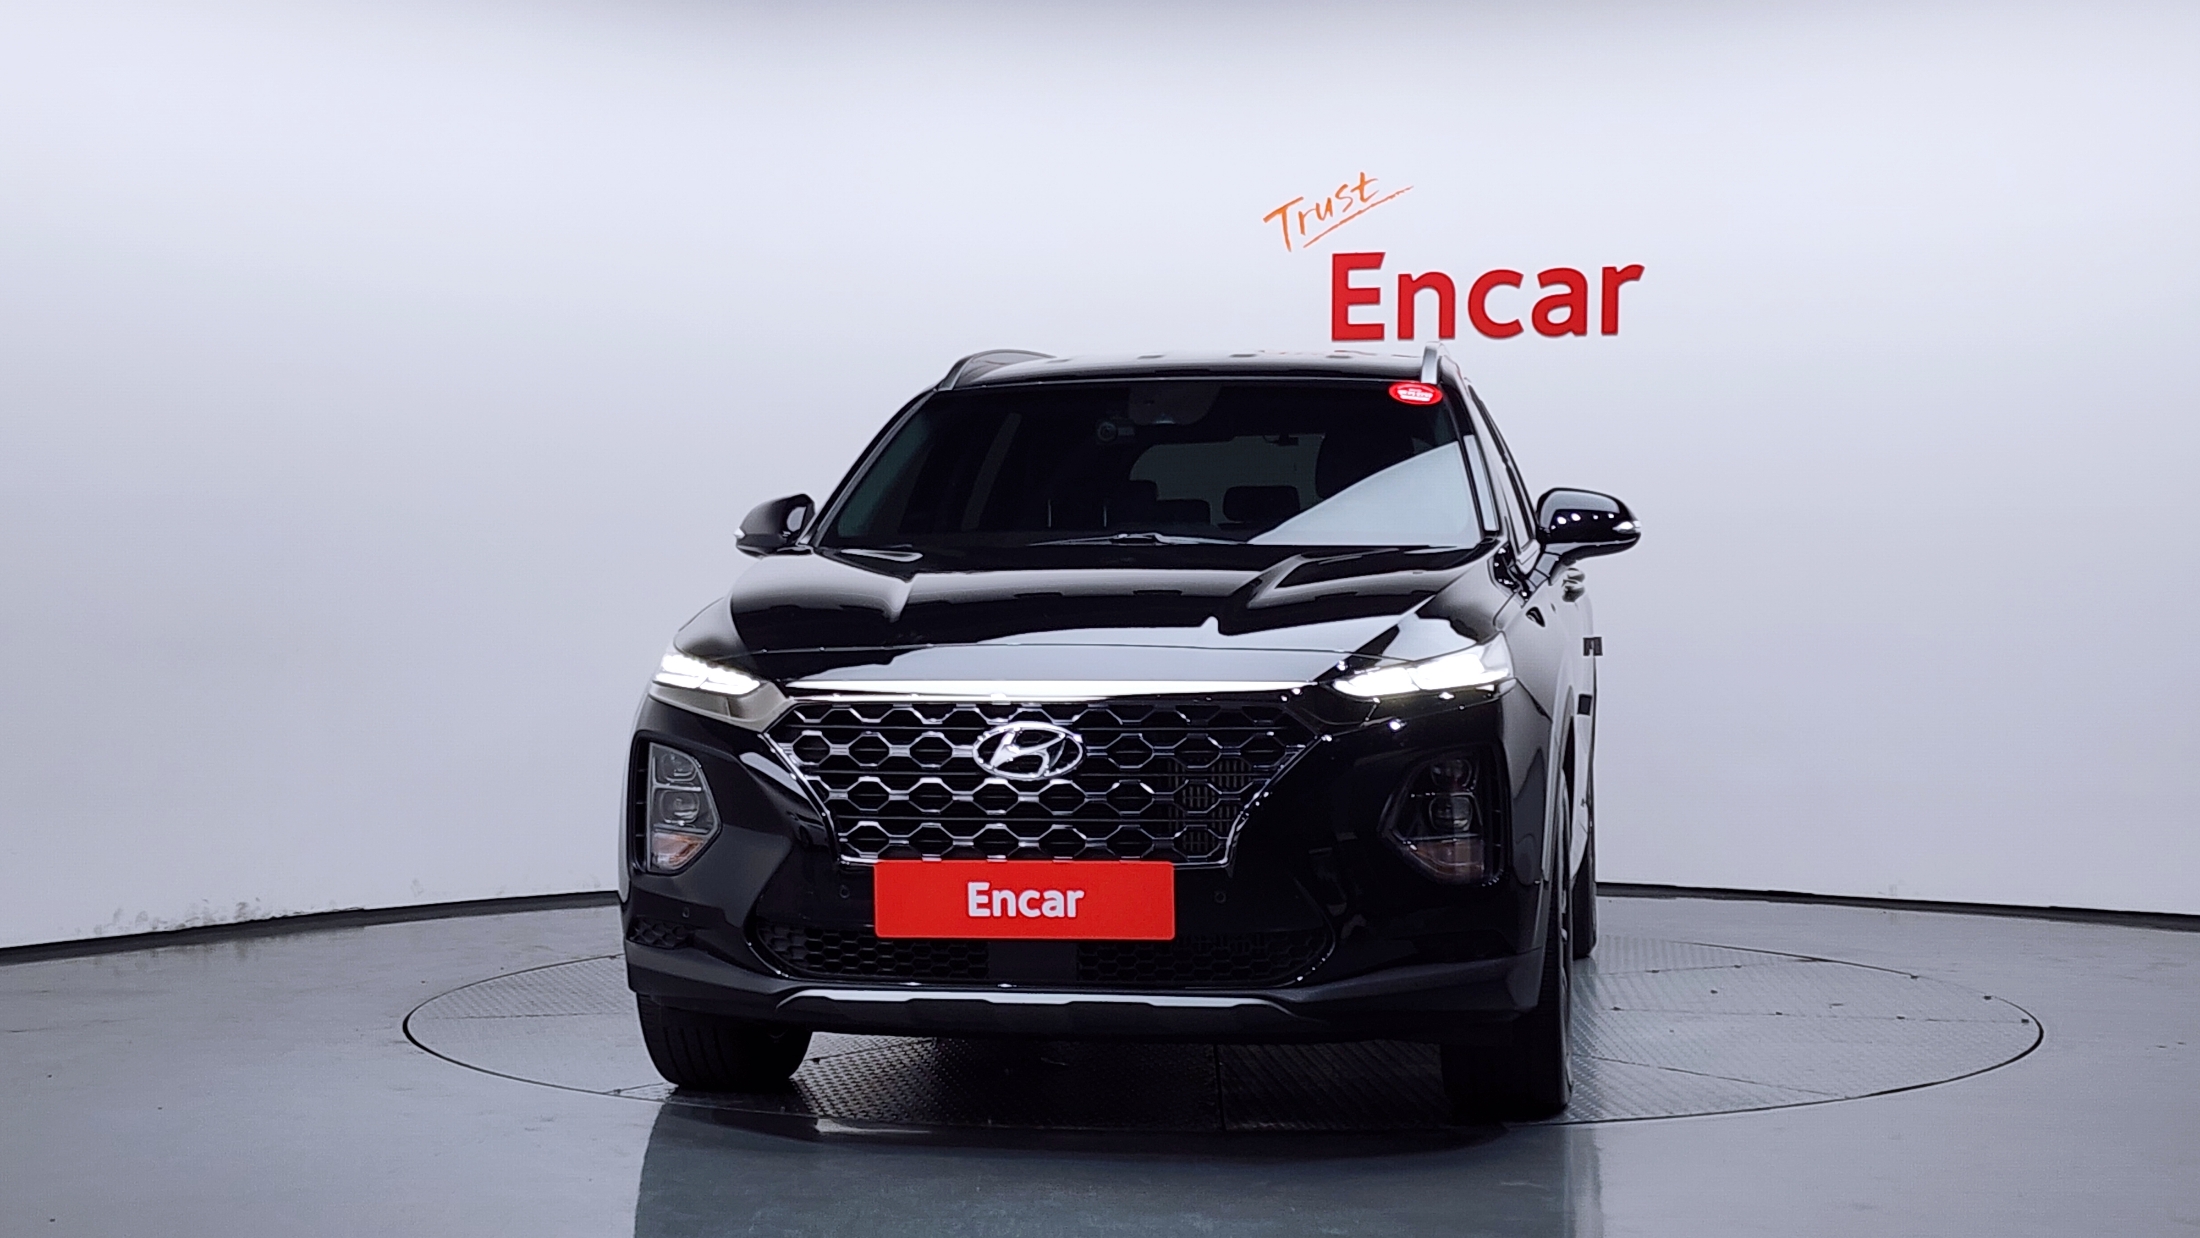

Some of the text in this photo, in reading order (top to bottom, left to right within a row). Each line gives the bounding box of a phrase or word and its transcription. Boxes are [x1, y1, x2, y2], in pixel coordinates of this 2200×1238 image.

[1263, 172, 1380, 251] Trust
[1331, 252, 1644, 340] Encar
[967, 881, 1085, 918] Encar
